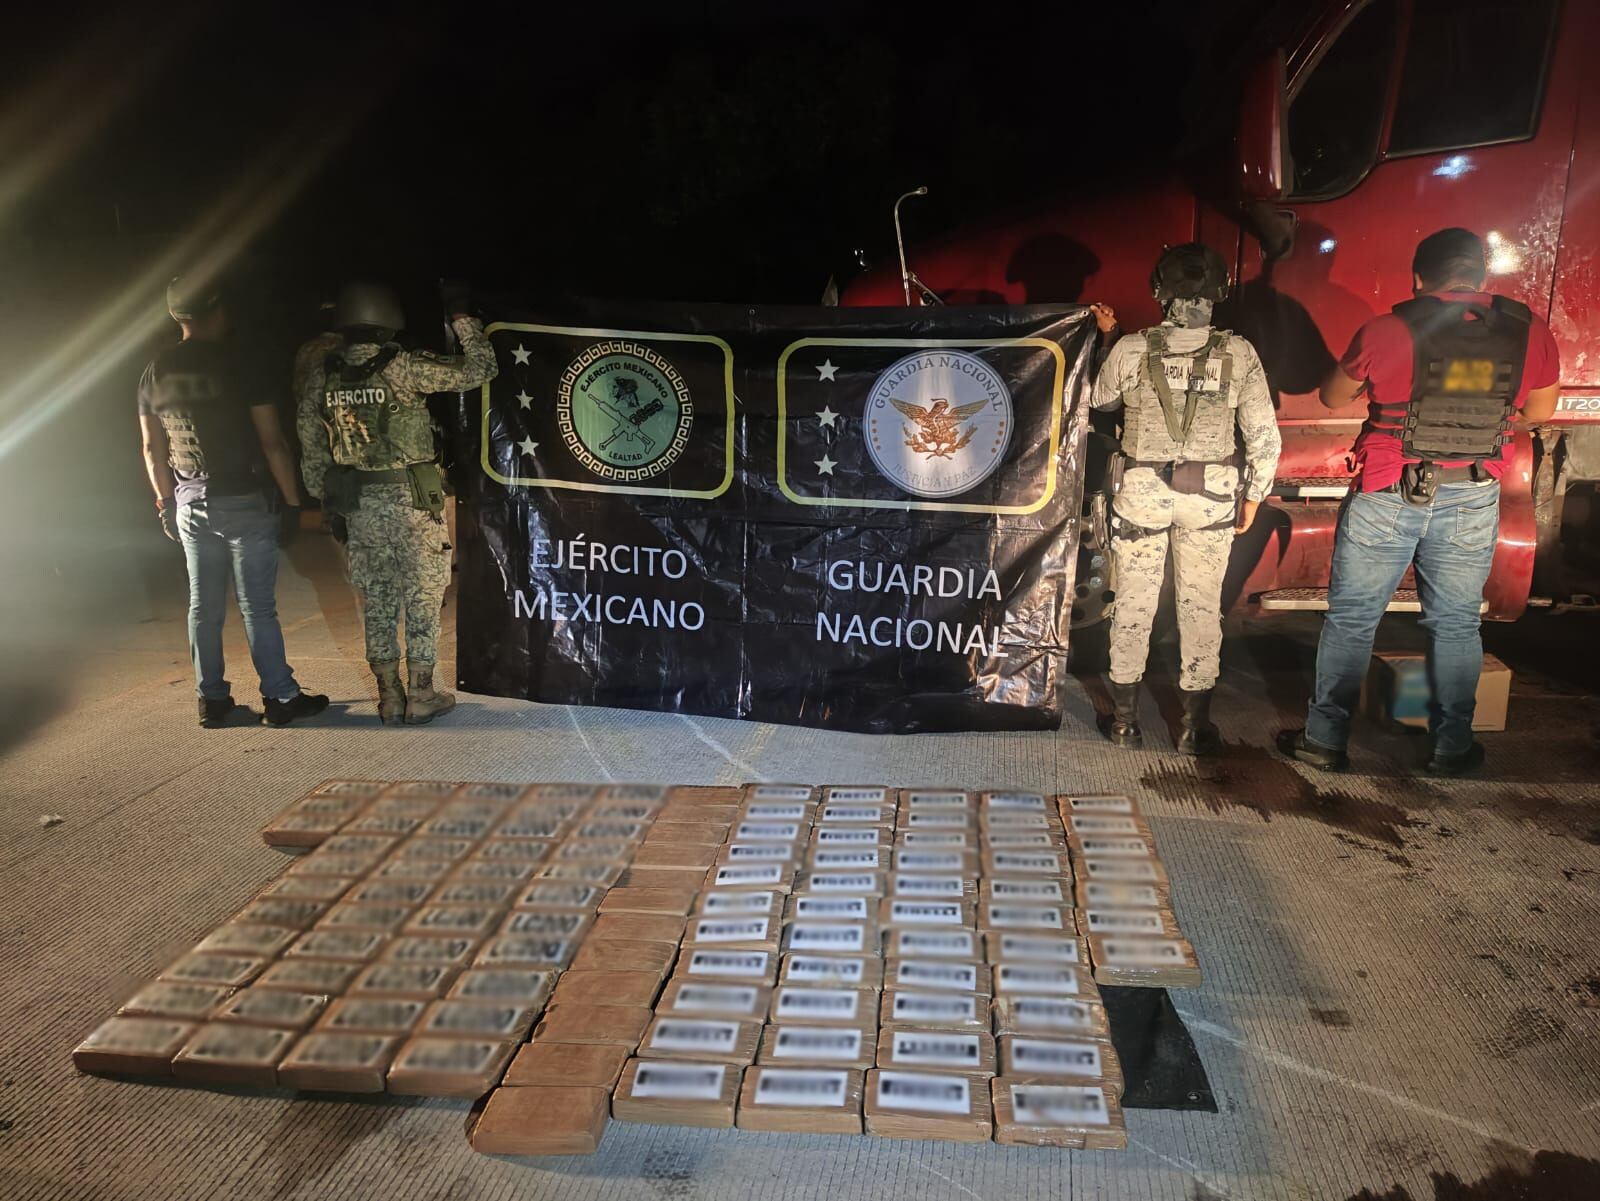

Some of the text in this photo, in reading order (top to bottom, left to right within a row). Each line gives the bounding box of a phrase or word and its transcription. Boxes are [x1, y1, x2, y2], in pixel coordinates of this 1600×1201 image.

[325, 388, 385, 408] EJERCITO
[623, 362, 669, 399] MEXICANO
[875, 356, 1003, 411] GUARDIA NACIONAL
[608, 450, 643, 462] LEALTAD
[530, 533, 687, 579] EJÉRCITO
[828, 560, 1002, 601] GUARDIA
[514, 590, 705, 631] MEXICANO
[816, 612, 1009, 658] NACIONAL
